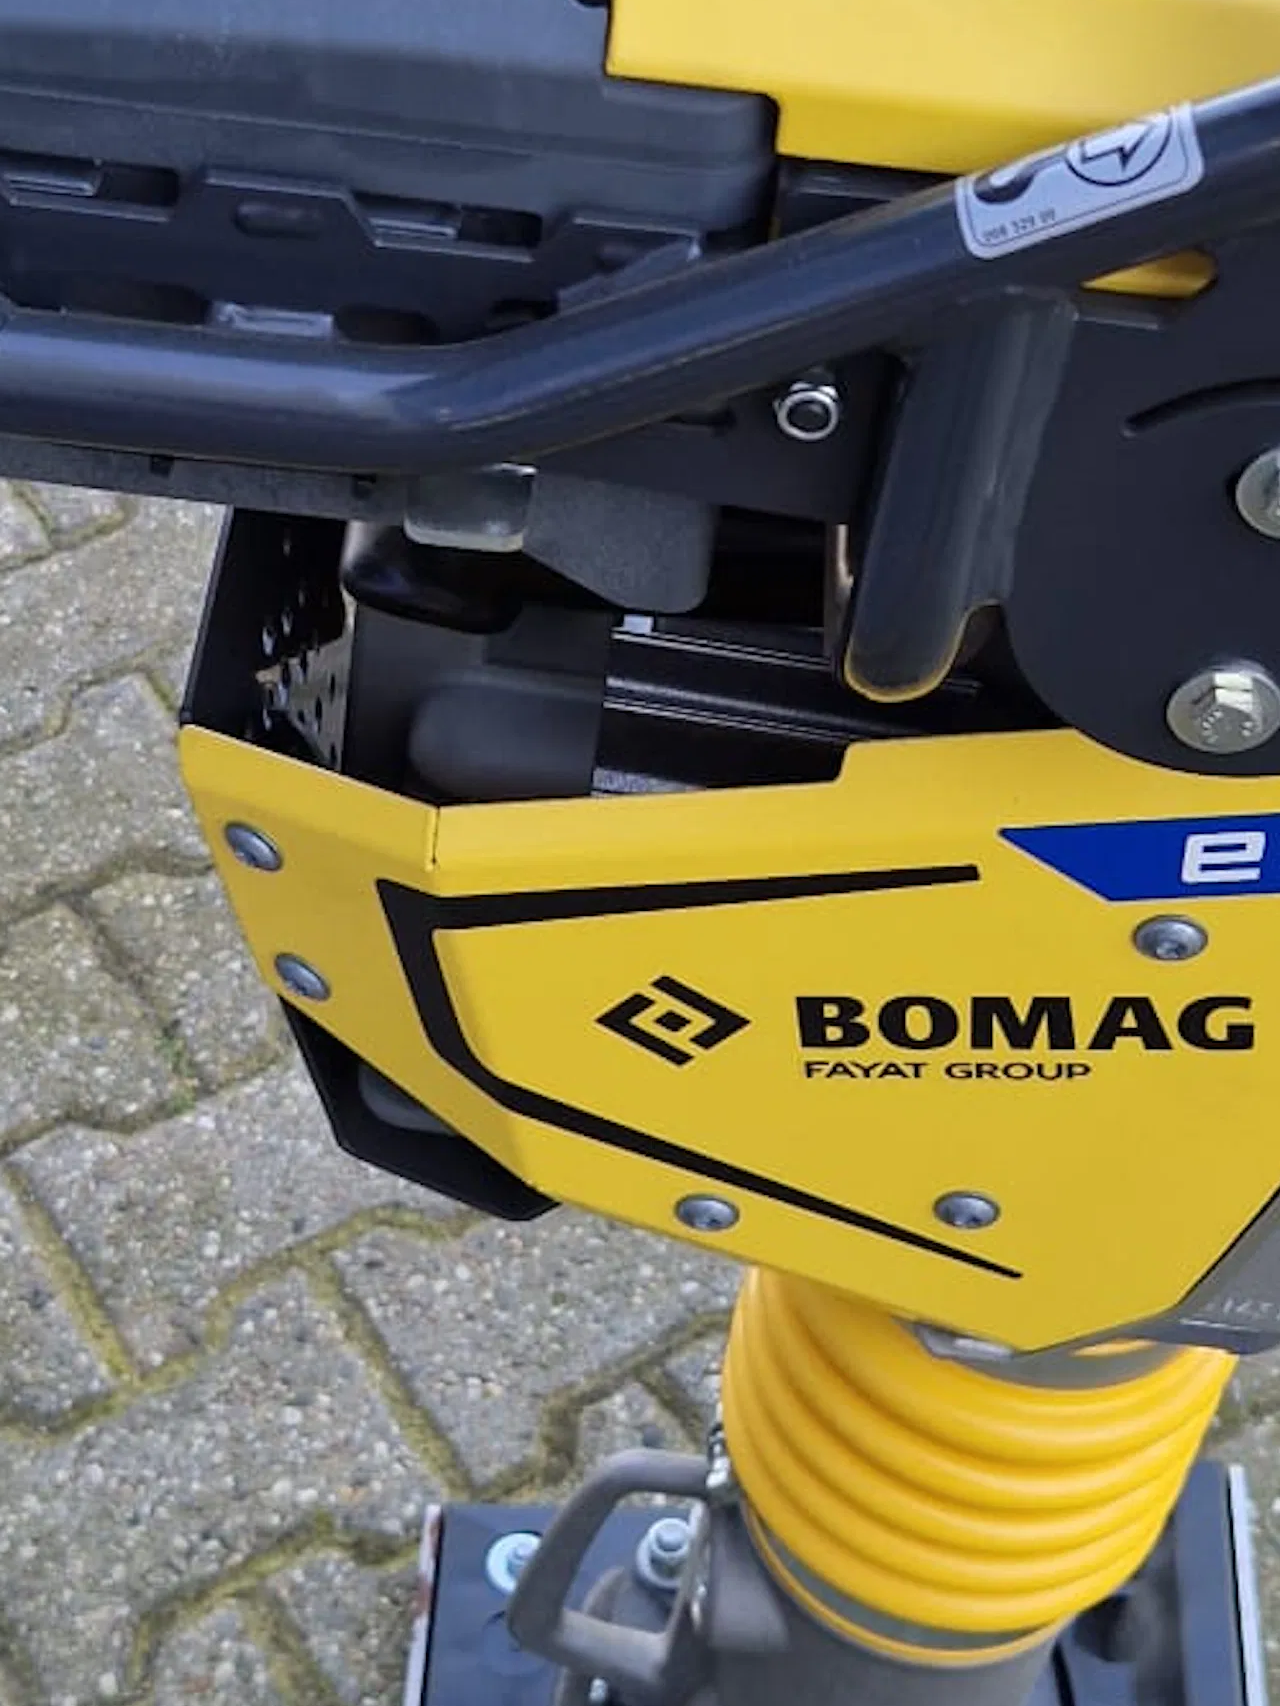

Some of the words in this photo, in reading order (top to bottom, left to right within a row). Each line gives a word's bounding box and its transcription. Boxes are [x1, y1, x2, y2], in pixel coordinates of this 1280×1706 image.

[796, 995, 1256, 1052] BOMAG
[804, 1059, 926, 1080] FAYAT
[944, 1061, 1092, 1082] GROUP
